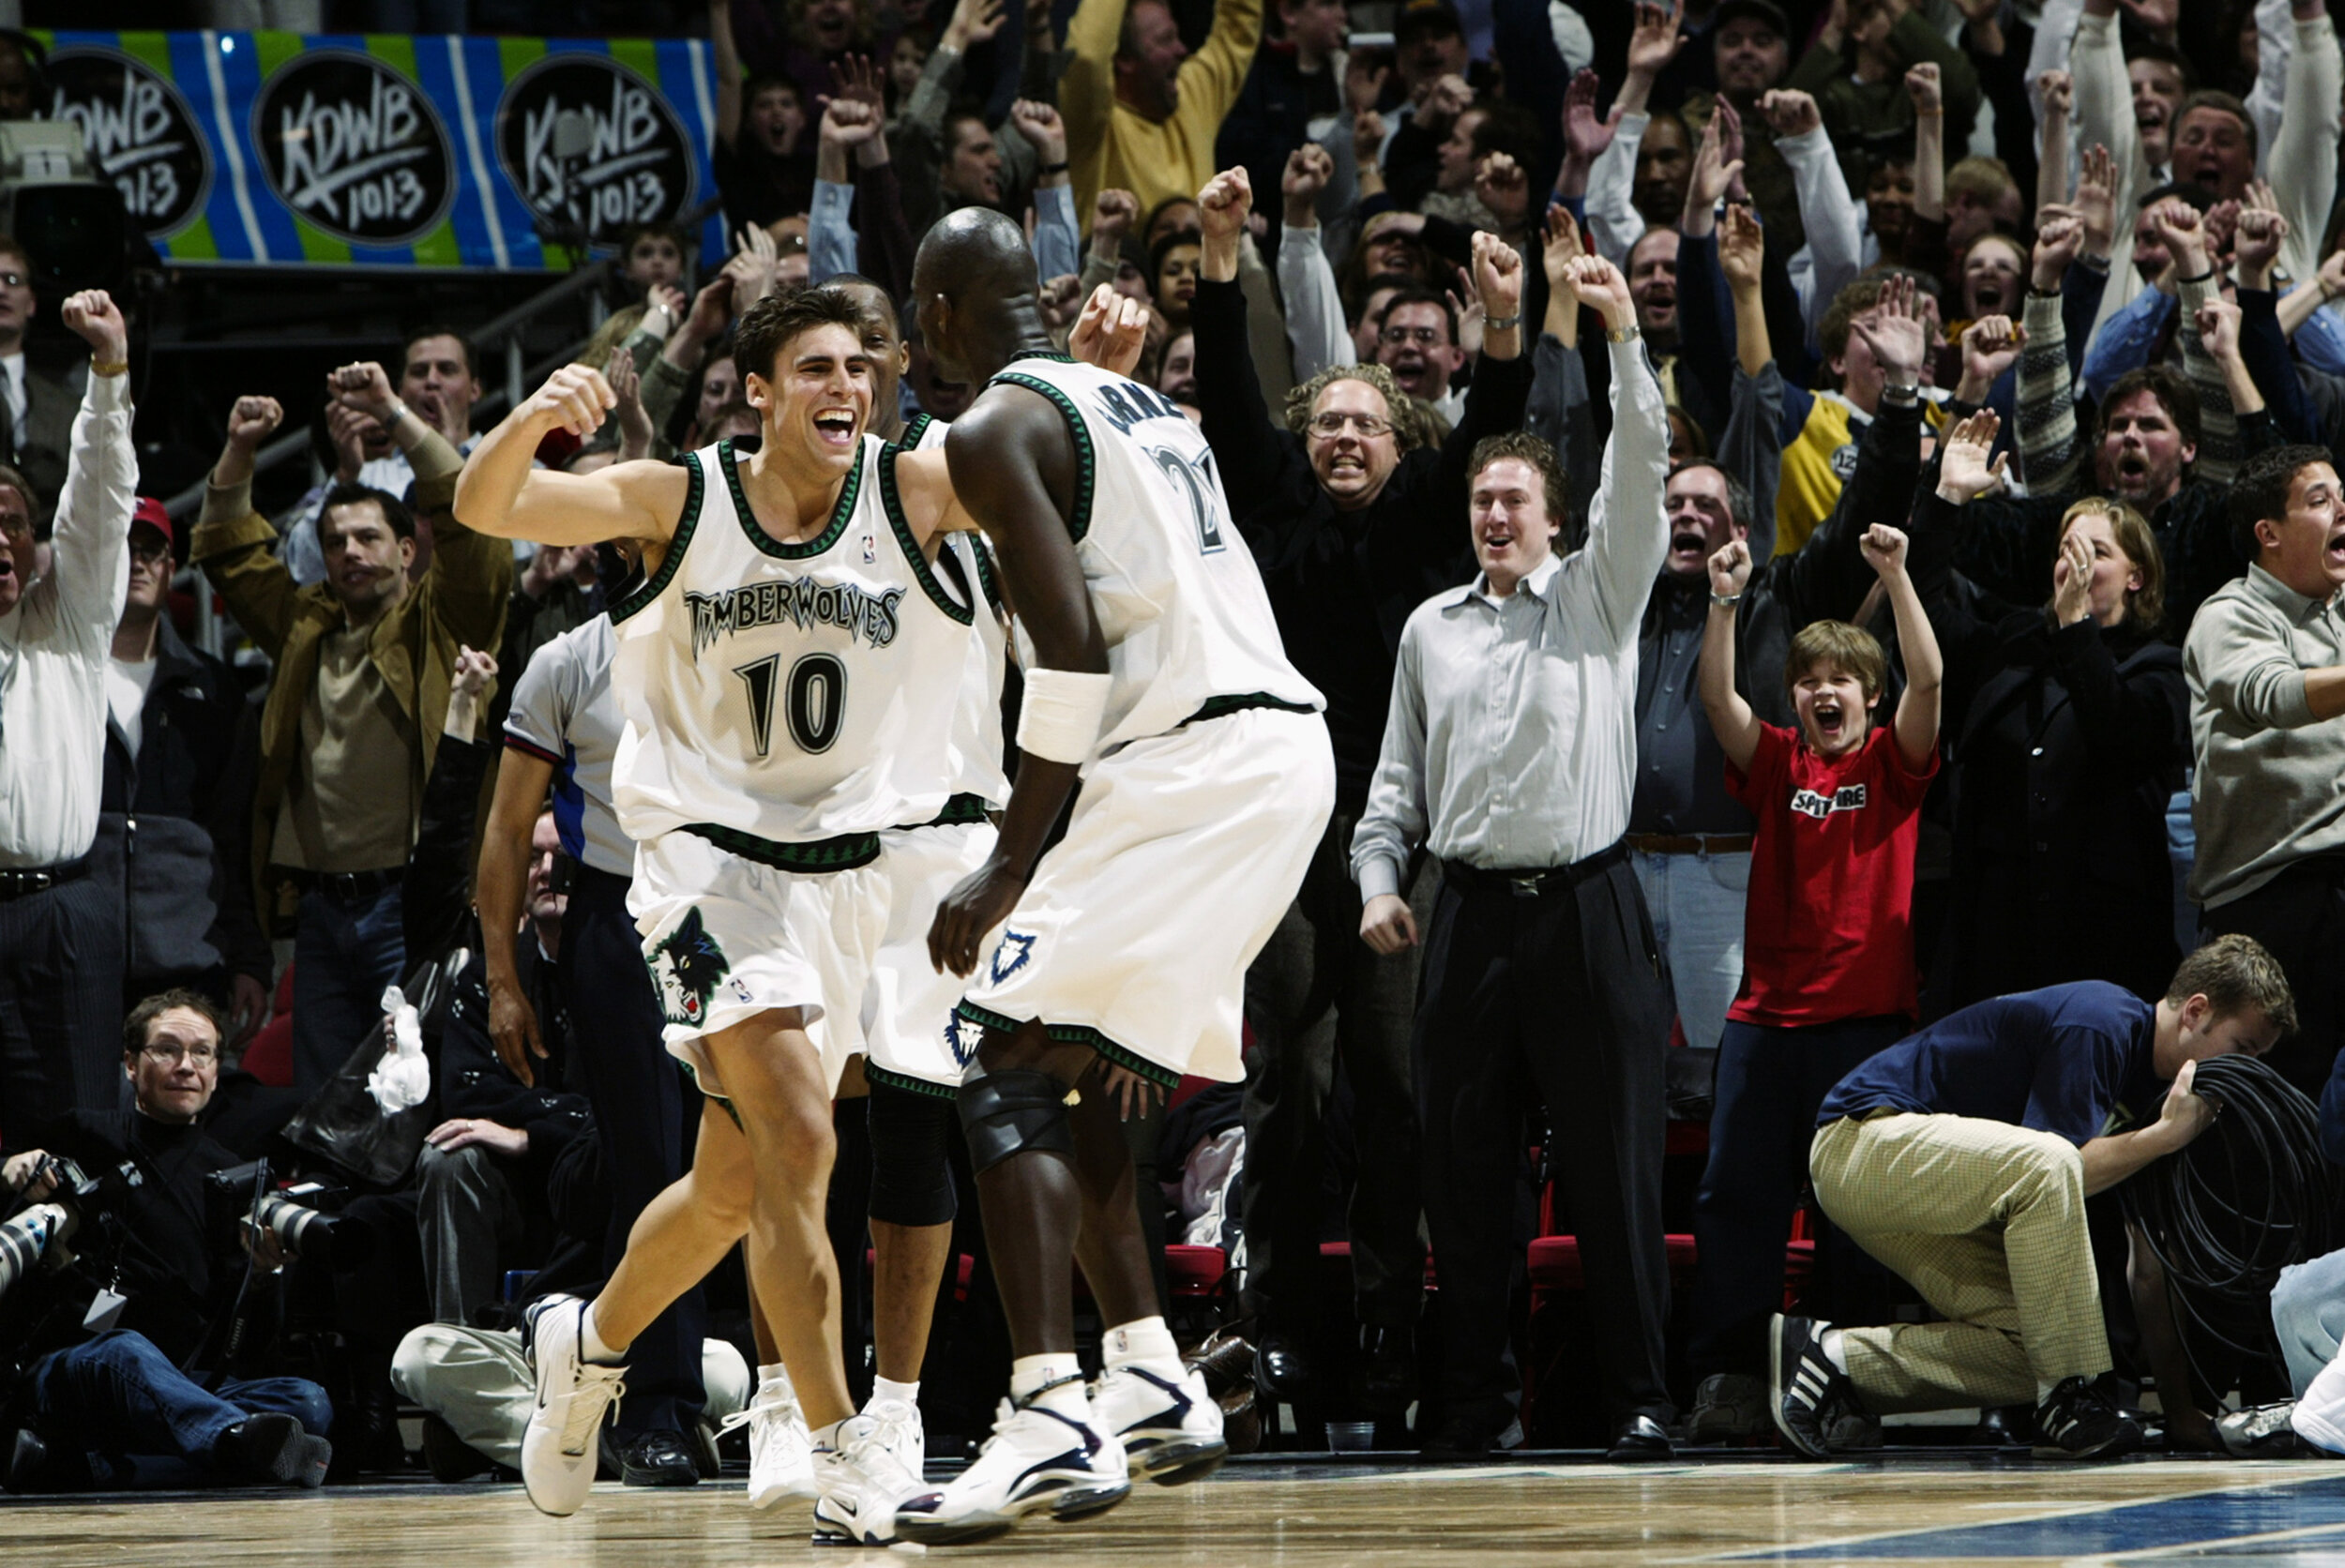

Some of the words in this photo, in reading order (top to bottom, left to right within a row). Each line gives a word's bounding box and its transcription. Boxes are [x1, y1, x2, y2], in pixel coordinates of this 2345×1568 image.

[35, 68, 172, 158] DWB
[283, 69, 419, 214] KDWB
[525, 71, 658, 211] KWB
[683, 576, 908, 665] TIMBERWOLVES
[732, 652, 848, 756] 10
[1793, 786, 1865, 815] SPITIRE
